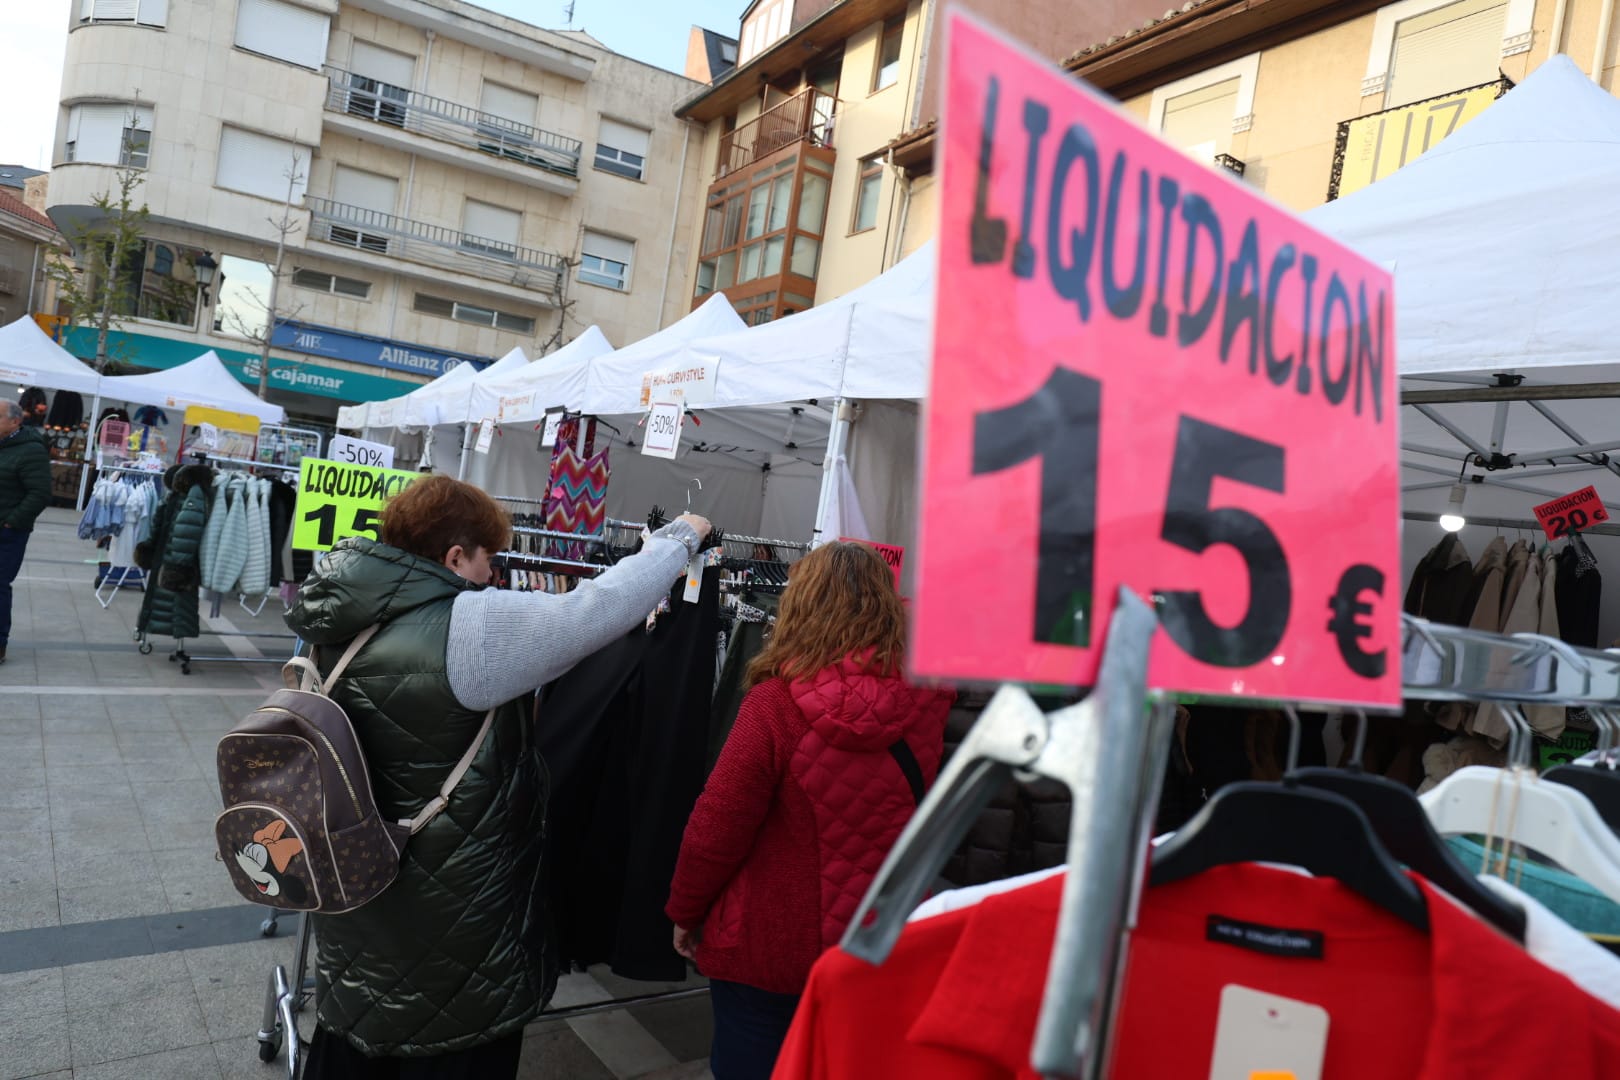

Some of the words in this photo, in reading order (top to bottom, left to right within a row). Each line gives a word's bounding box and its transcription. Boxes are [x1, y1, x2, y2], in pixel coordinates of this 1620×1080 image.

[969, 74, 1386, 425] LIQUIDACION
[379, 346, 440, 371] Allianz
[271, 366, 344, 390] cajamar
[651, 414, 675, 435] -50%
[338, 443, 385, 468] -50%
[1537, 490, 1595, 518] LIQUIDACION
[304, 503, 384, 546] 15
[971, 364, 1293, 668] 15
[1327, 563, 1387, 679] €
[1547, 508, 1588, 538] 20
